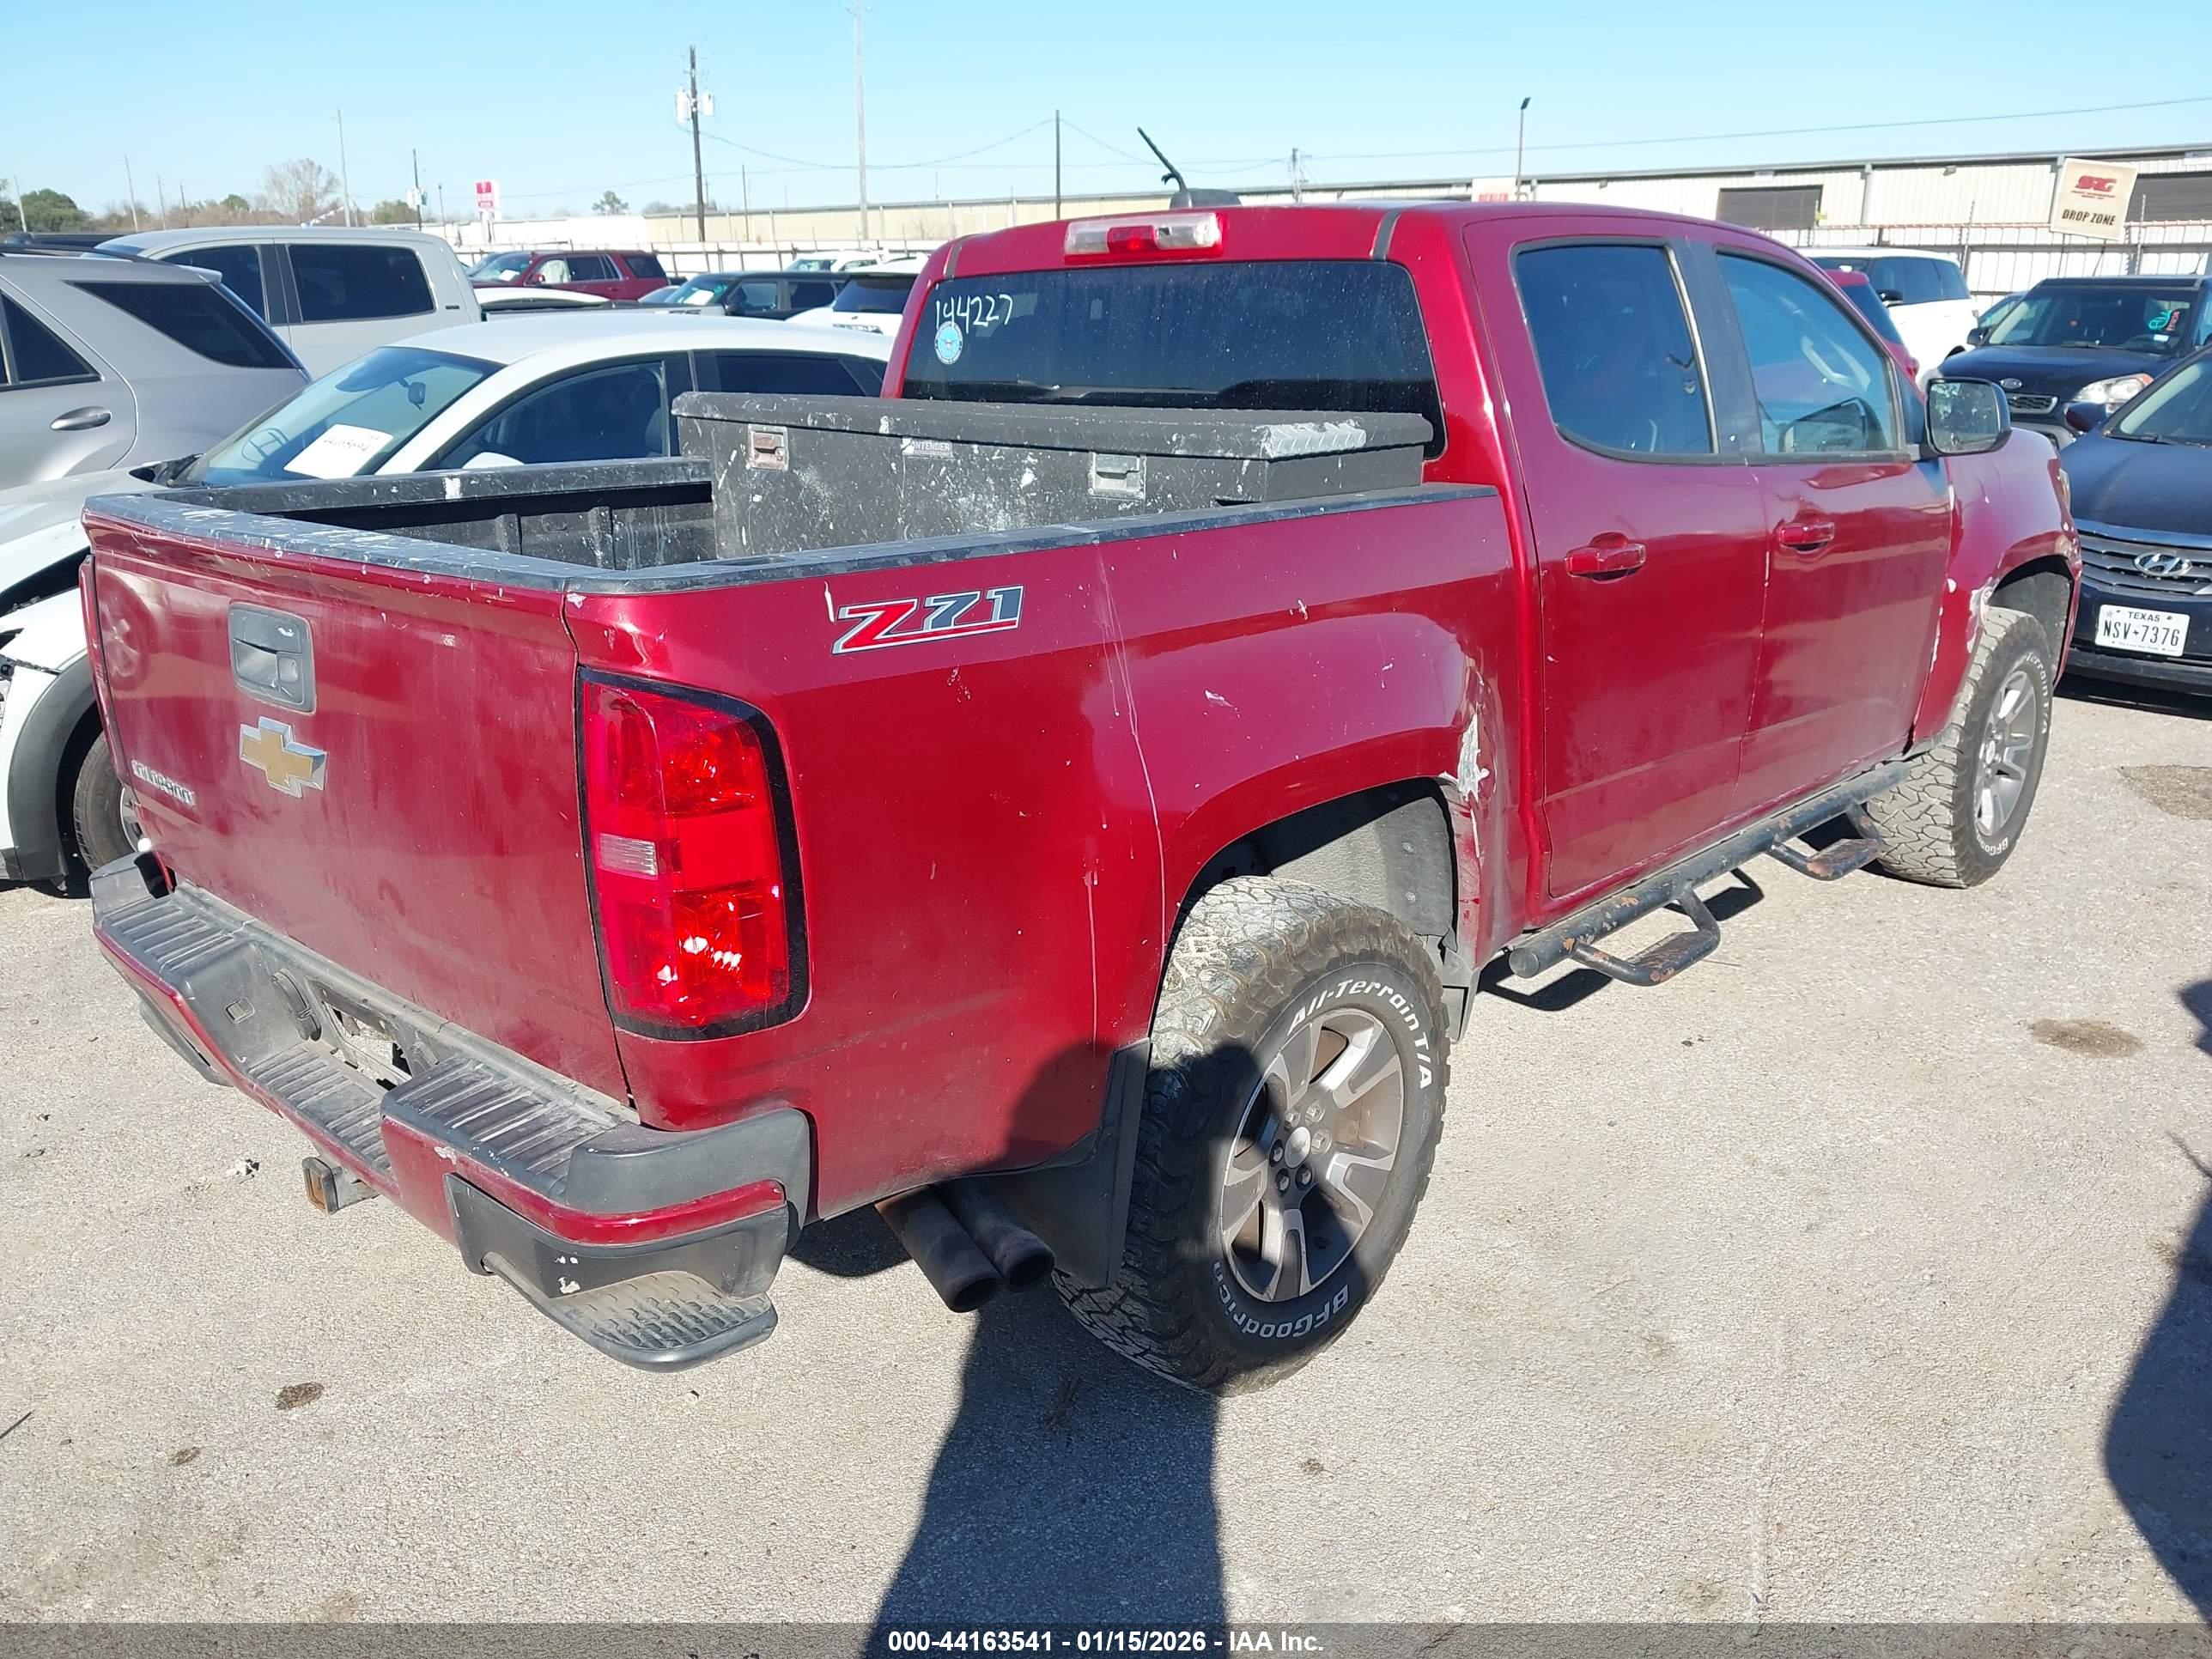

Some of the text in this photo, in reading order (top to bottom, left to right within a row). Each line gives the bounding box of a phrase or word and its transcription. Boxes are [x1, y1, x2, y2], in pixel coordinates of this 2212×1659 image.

[2062, 209, 2117, 226] DROP ZONE
[935, 294, 1013, 334] 144227
[831, 584, 1024, 655] Z71
[2128, 611, 2160, 623] TEXAS
[1287, 979, 1432, 1089] All-Terrain T/A
[1213, 1261, 1349, 1339] BFGoodrich
